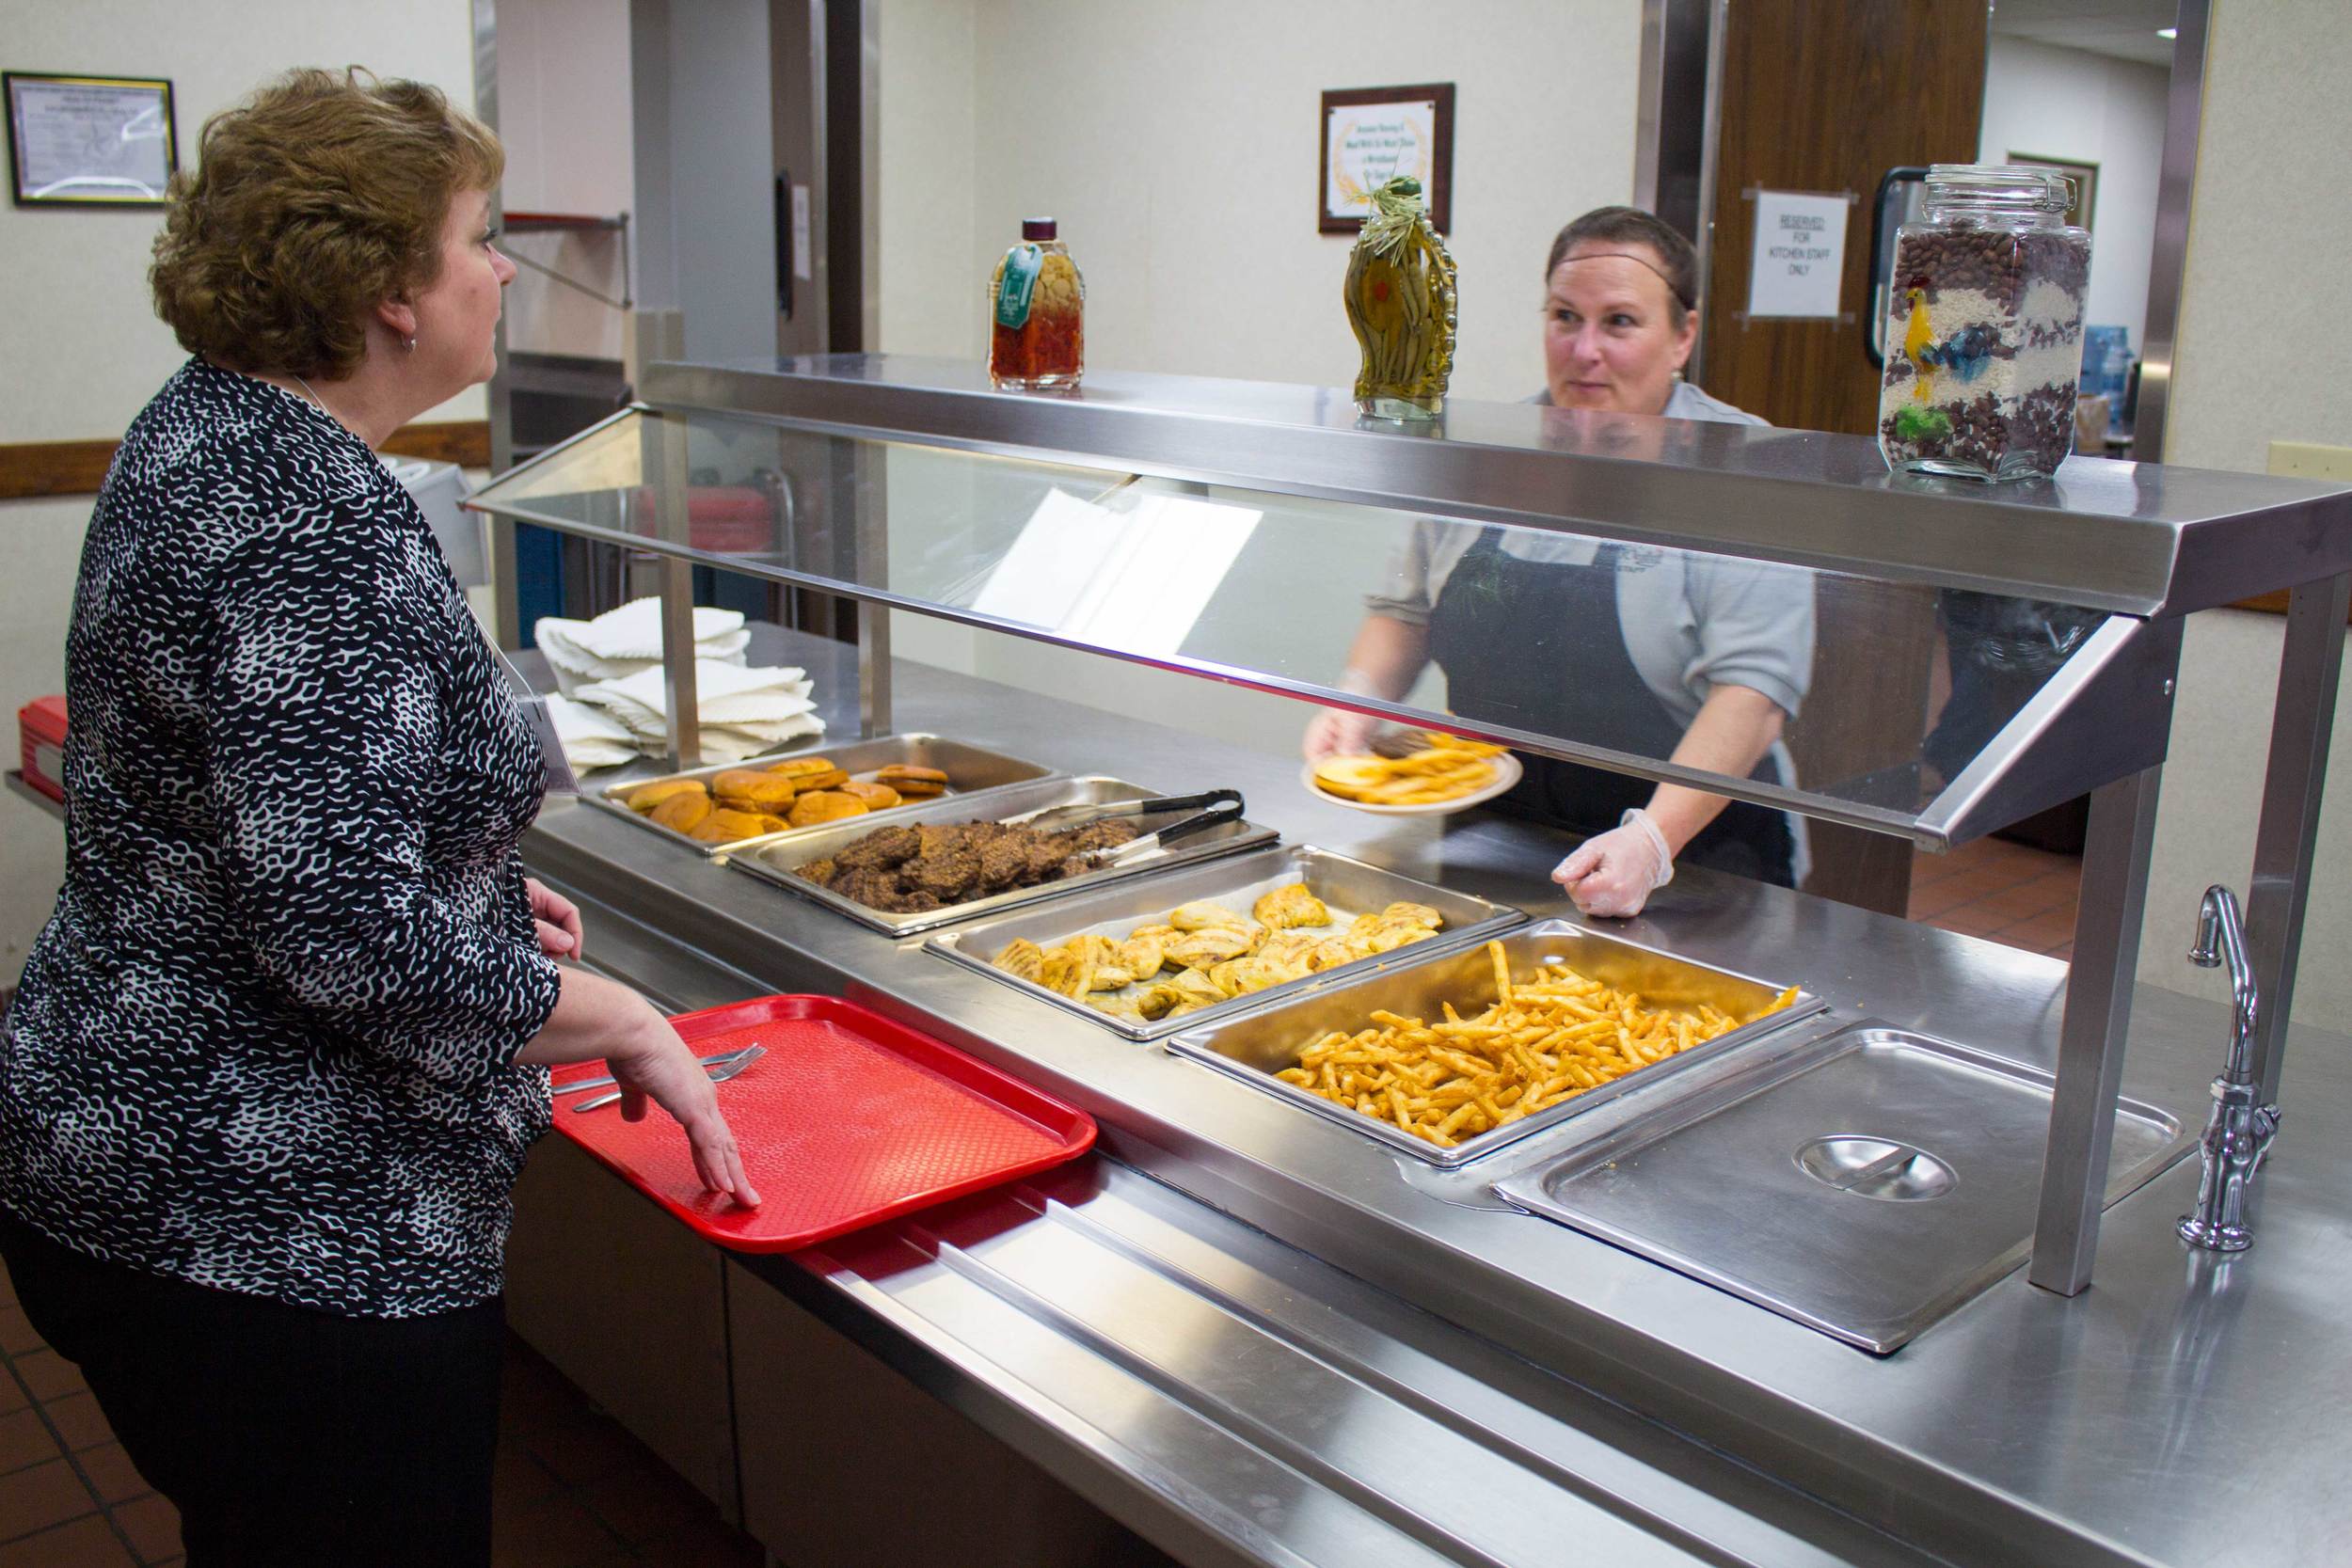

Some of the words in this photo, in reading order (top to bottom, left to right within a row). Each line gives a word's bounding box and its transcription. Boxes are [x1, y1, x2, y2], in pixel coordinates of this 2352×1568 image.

[1780, 214, 1825, 229] RESERVED
[1793, 231, 1810, 243] FOR
[1770, 247, 1805, 260] KITCHEN
[1807, 249, 1831, 261] STAFF
[1788, 264, 1809, 276] ONLY
